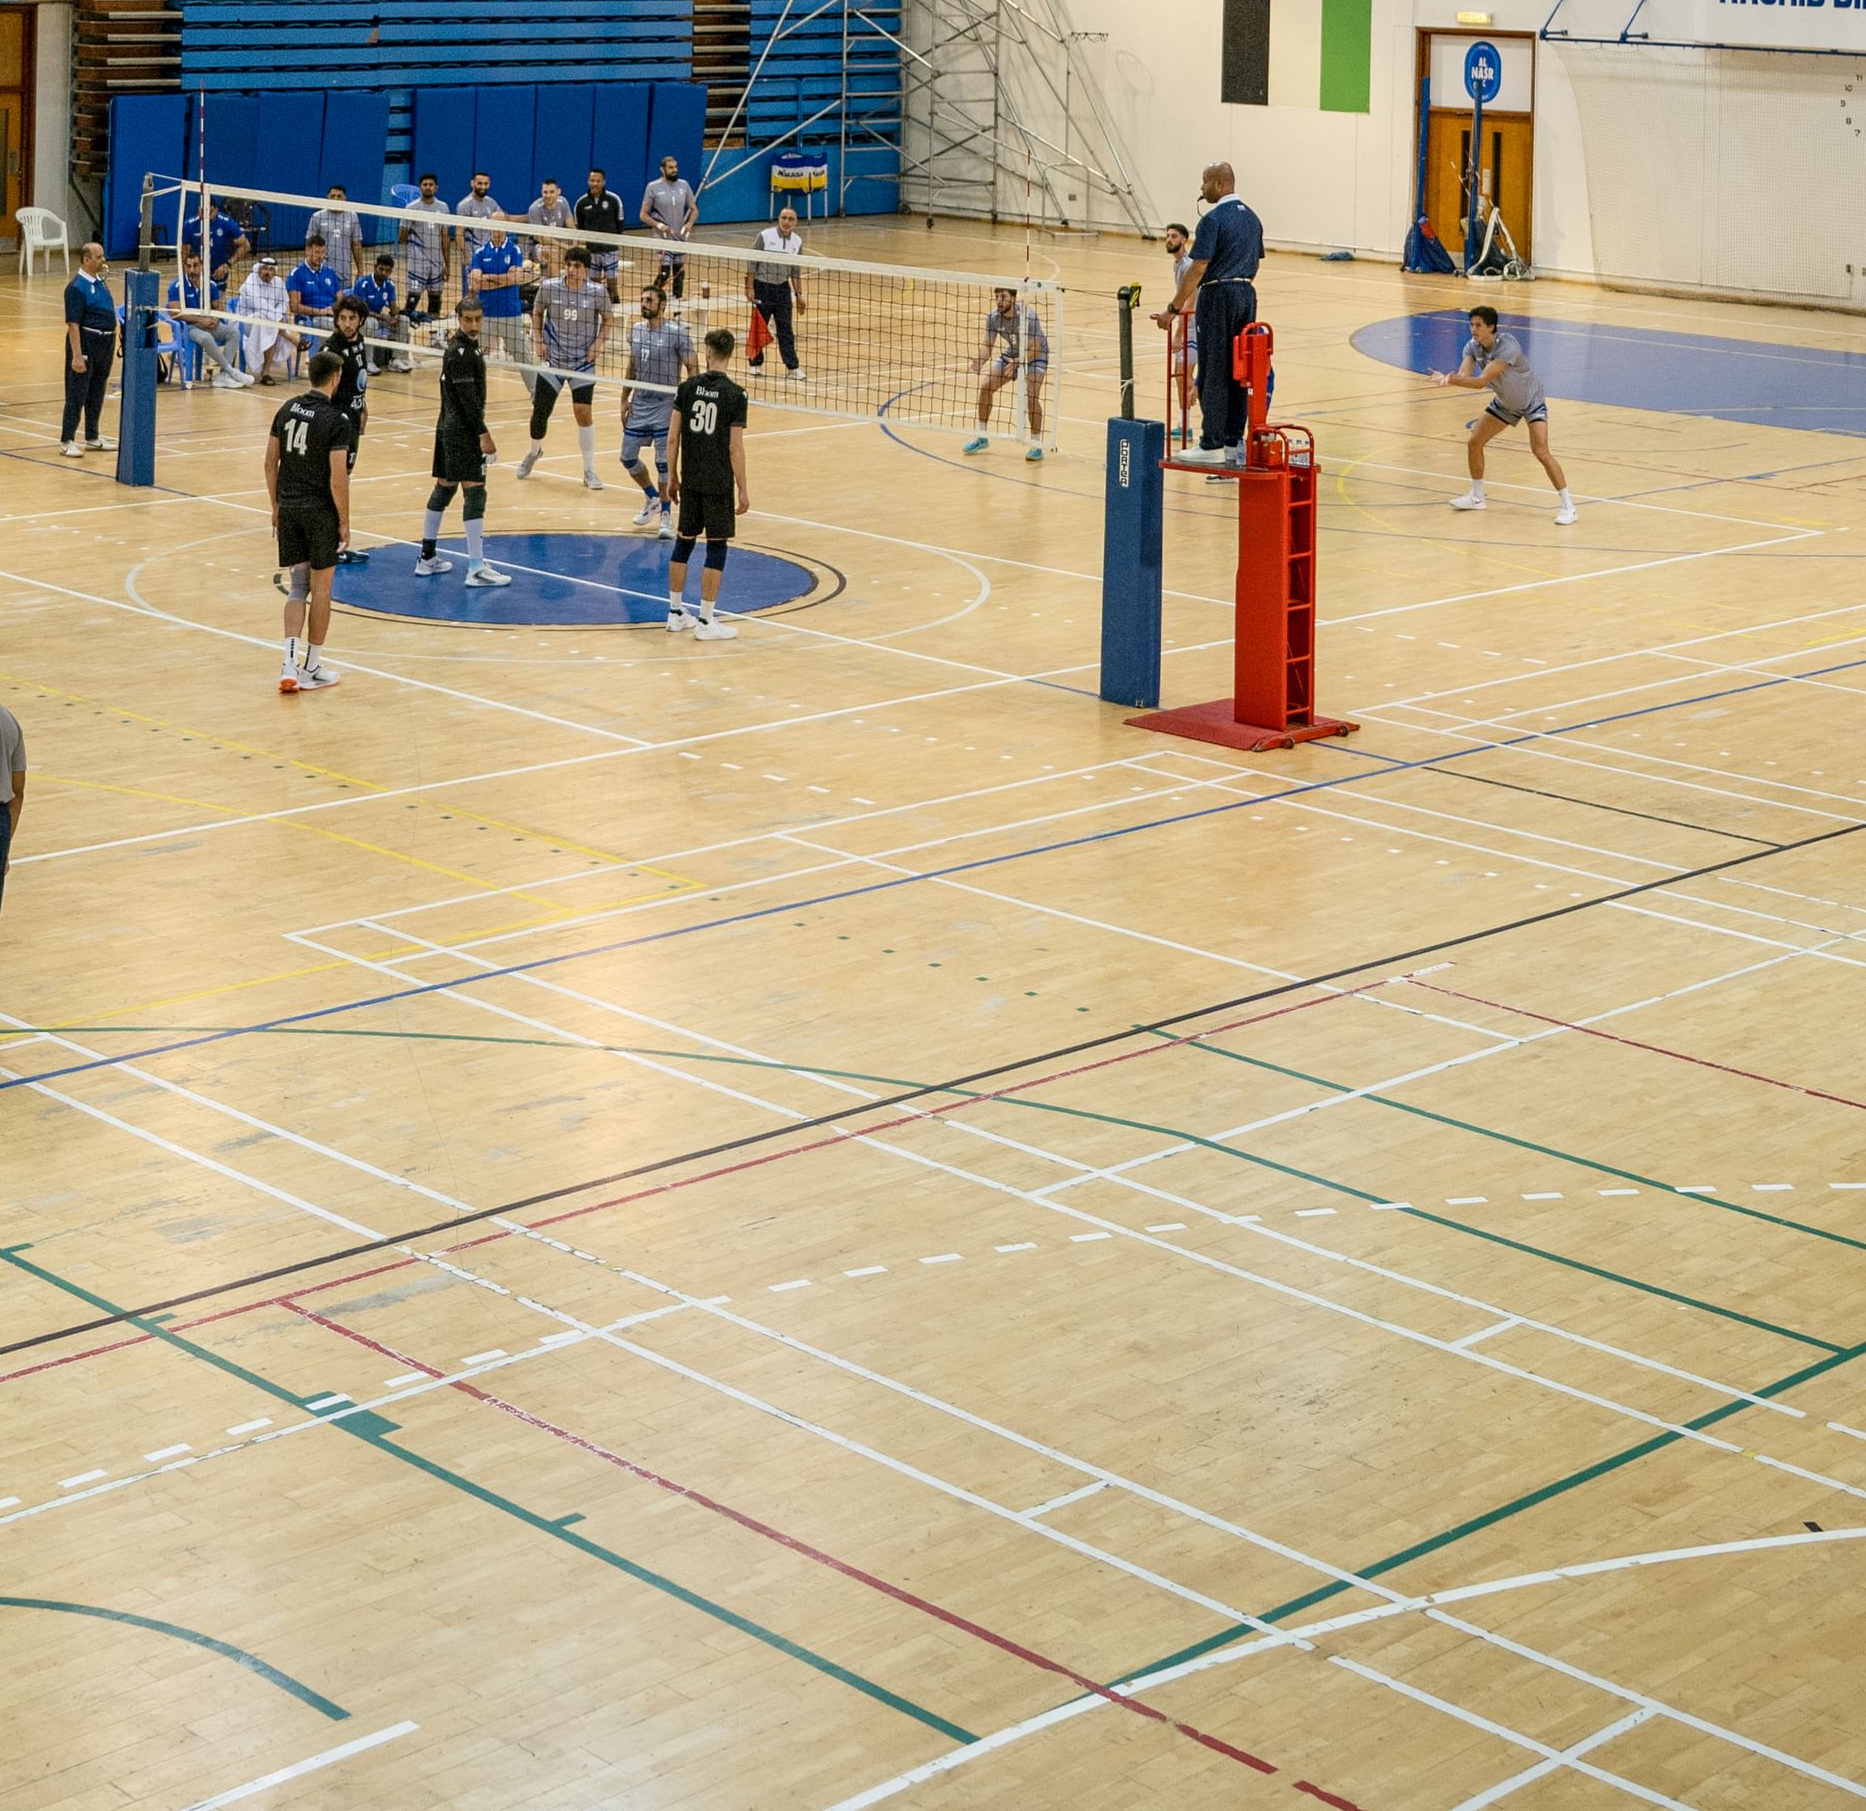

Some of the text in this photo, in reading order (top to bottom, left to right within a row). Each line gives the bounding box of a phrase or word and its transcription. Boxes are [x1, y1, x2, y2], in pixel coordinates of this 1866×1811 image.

[1478, 56, 1487, 67] AL
[1471, 66, 1494, 80] NASR
[563, 308, 578, 321] 99
[689, 399, 718, 435] 30
[284, 418, 309, 456] 14
